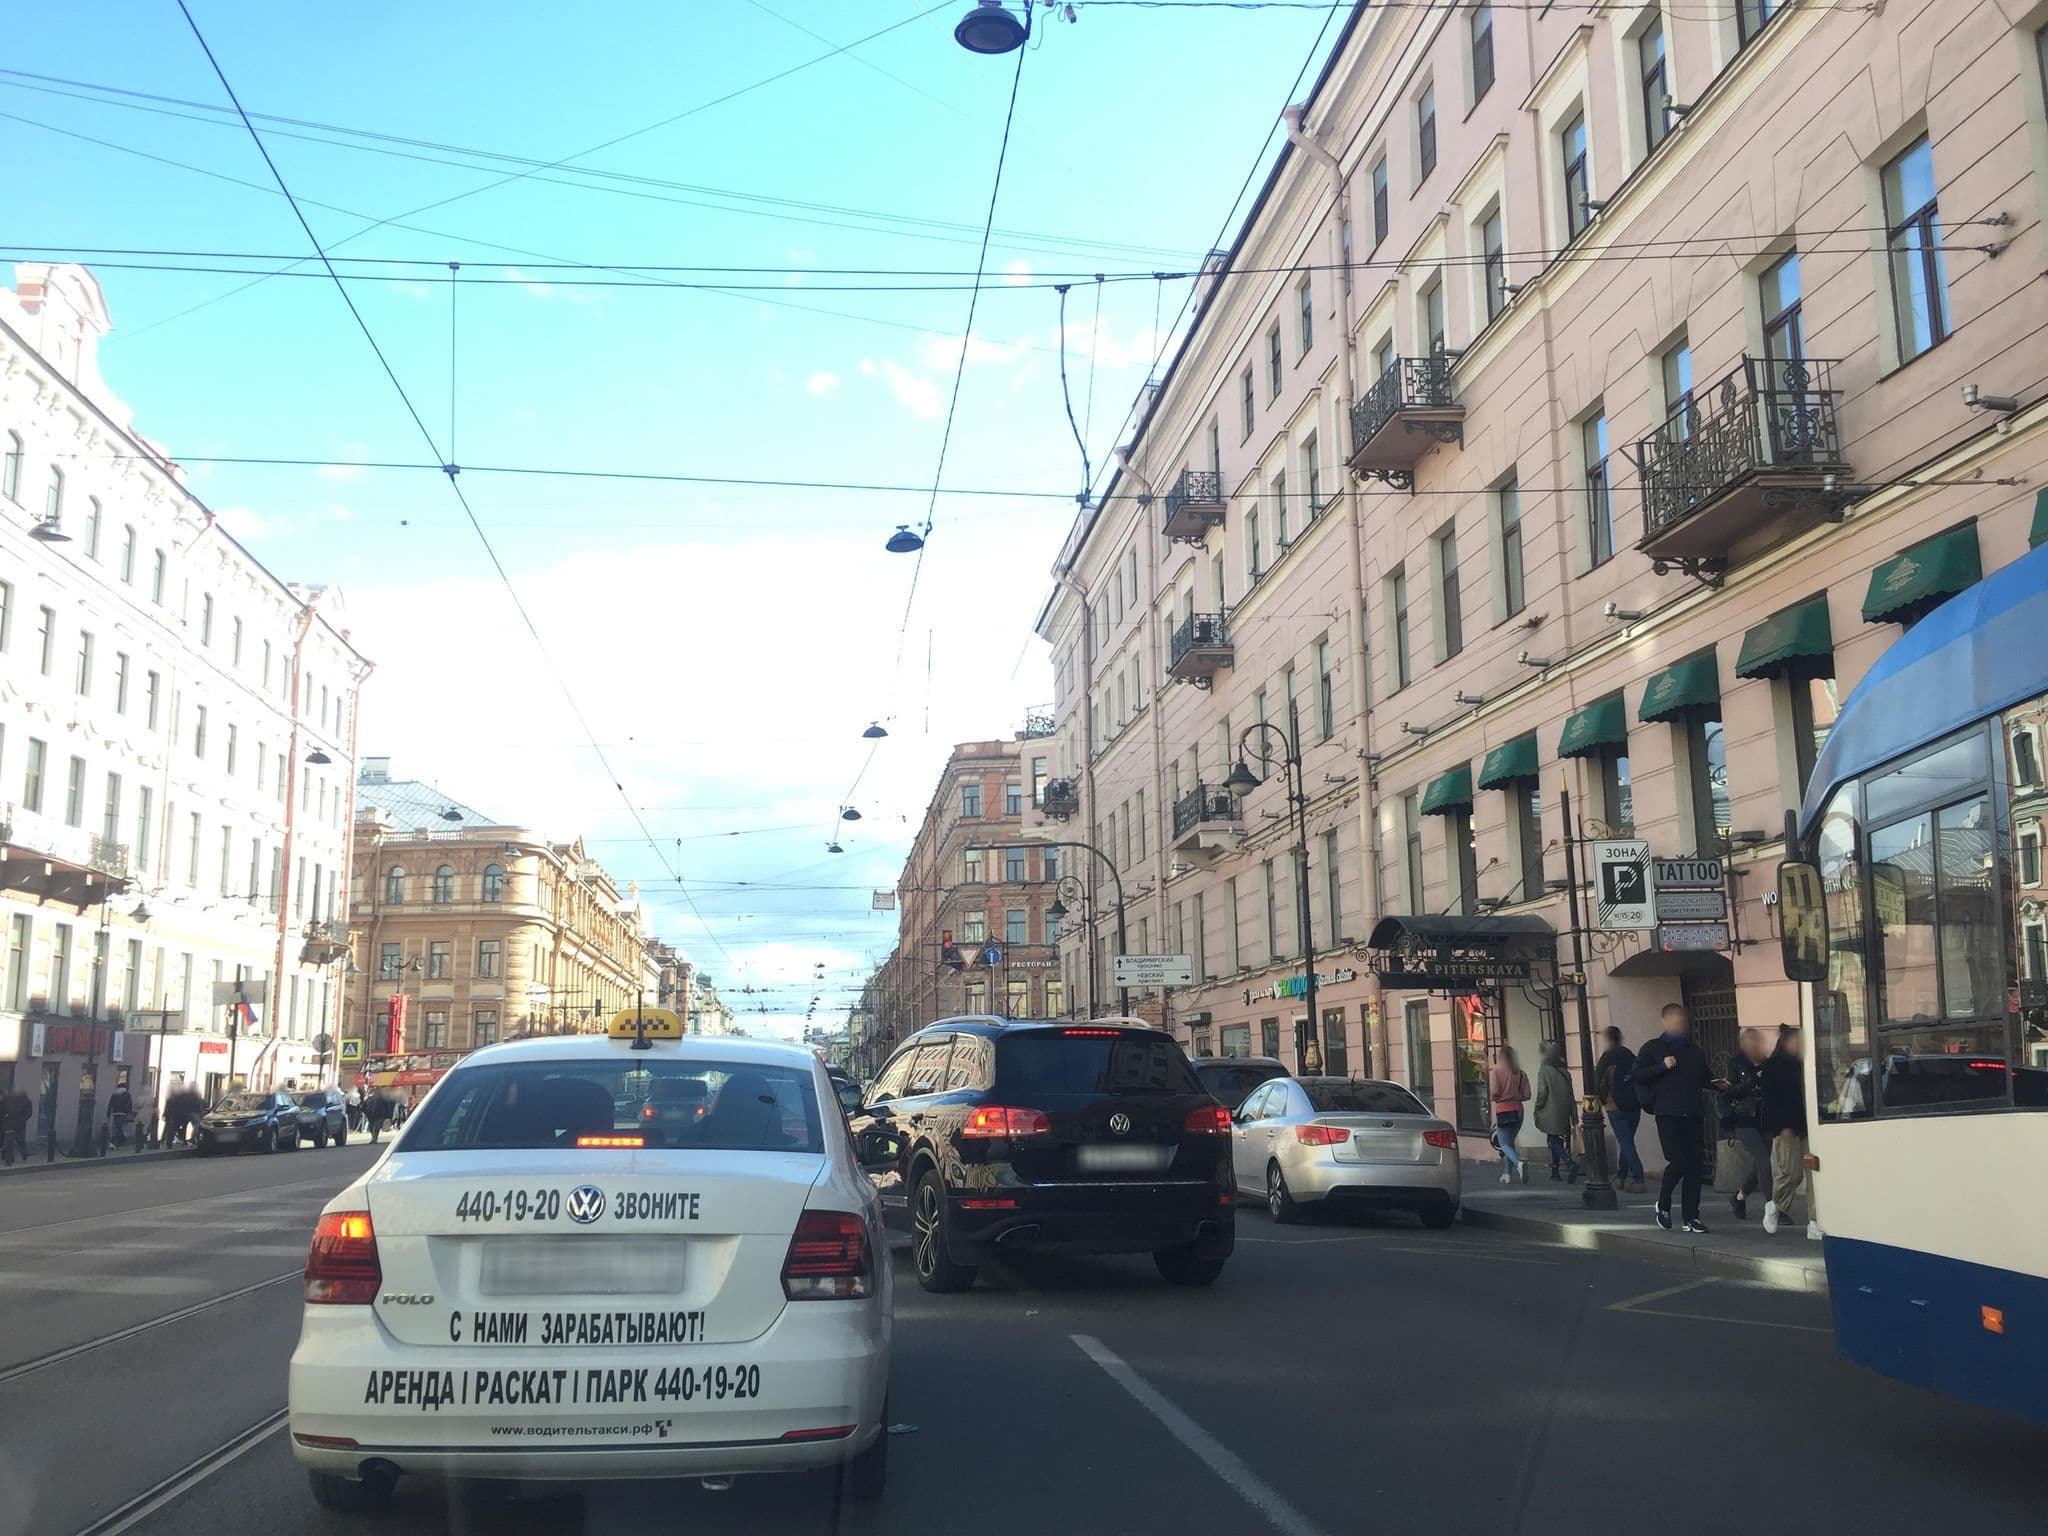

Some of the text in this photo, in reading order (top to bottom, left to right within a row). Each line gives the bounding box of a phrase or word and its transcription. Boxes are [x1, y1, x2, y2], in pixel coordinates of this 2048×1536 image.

[1606, 848, 1637, 858] ЗОНА
[1657, 862, 1719, 880] TATTOO
[1631, 911, 1641, 919] 20
[1434, 964, 1522, 976] PITERSKAYA
[456, 1189, 700, 1222] 440-19-20 ЗВОНИТЕ
[383, 1294, 435, 1305] POLO
[449, 1311, 705, 1344] С НАМИ ЗАРАБАТЫВАЮТ!
[365, 1370, 455, 1411] АРЕНДА
[475, 1370, 567, 1404] РАСКАТ
[586, 1368, 649, 1403] ПАРК
[653, 1364, 760, 1402] 440-19-20
[491, 1423, 653, 1437] www.водительтакси.рф
